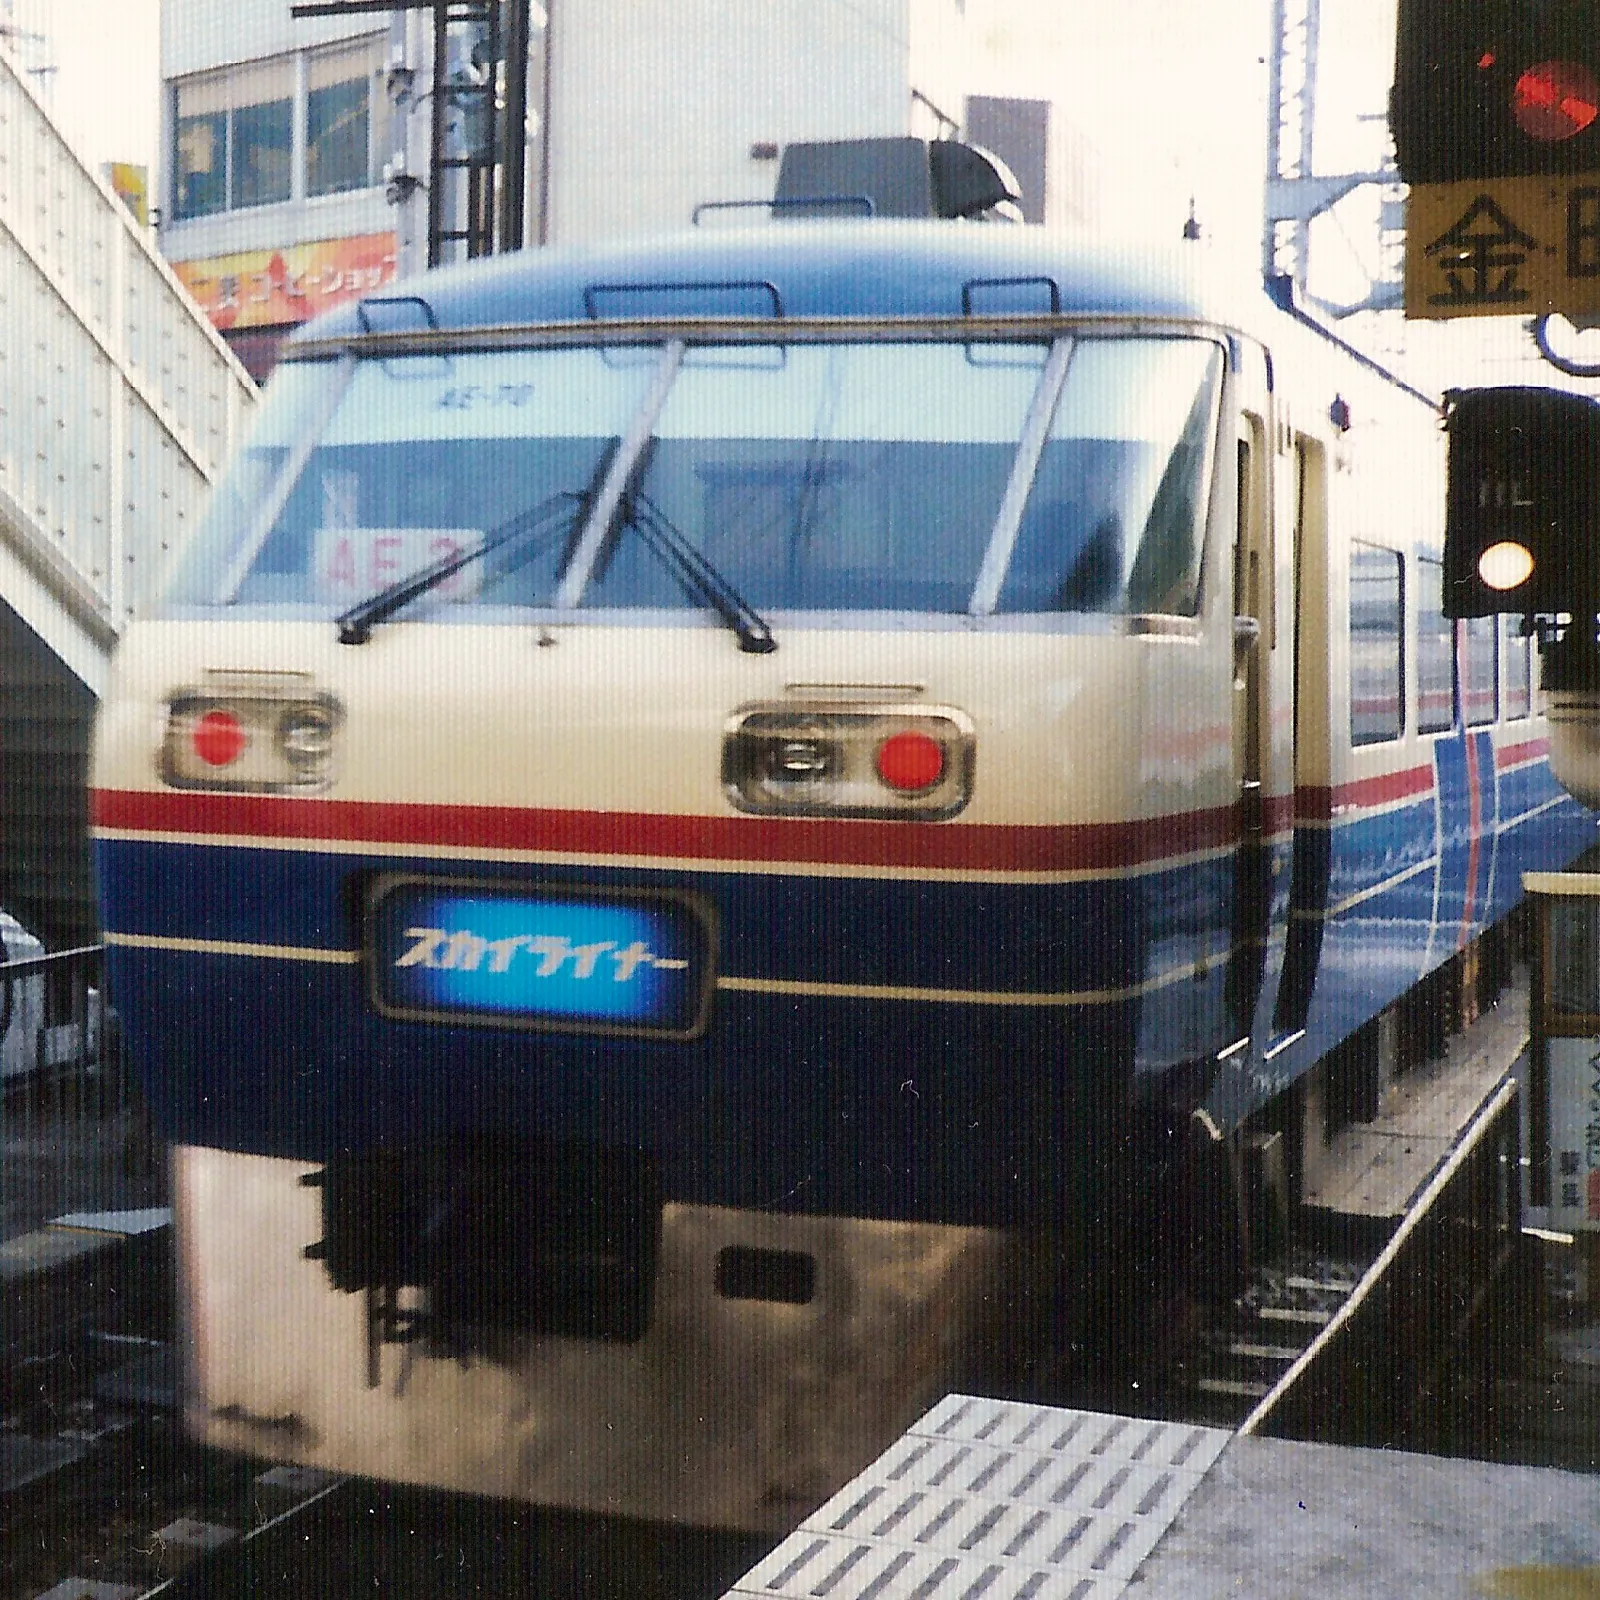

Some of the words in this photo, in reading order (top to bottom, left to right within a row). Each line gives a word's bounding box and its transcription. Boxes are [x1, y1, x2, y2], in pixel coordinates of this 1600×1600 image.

[394, 927, 690, 983] スカイライナー
